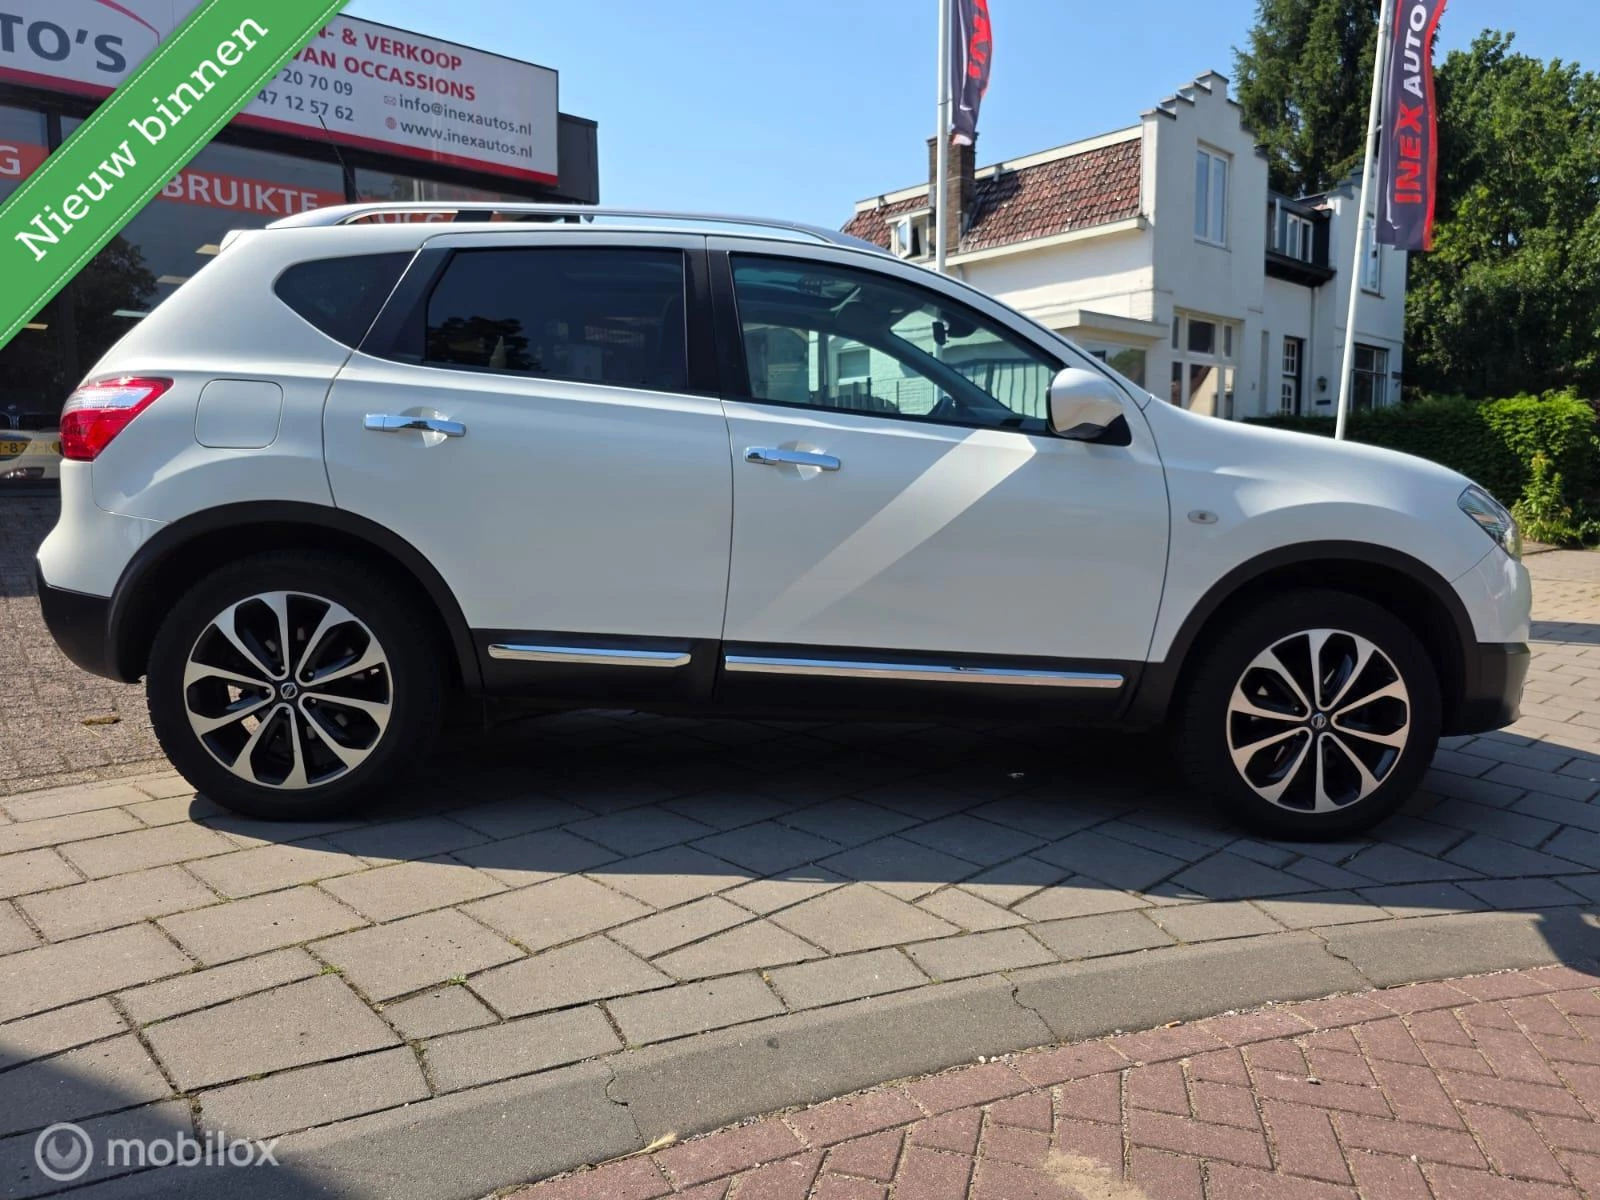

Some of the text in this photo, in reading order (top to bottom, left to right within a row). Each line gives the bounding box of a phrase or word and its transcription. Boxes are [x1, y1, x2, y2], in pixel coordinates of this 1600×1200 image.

[342, 28, 357, 47] &
[365, 33, 462, 71] VERKOOP
[283, 69, 353, 96] 20 70 09
[344, 56, 476, 102] OCCASSIONS
[257, 89, 354, 121] 47 12 57 62
[400, 94, 532, 136] info@inexautos.nl
[1394, 0, 1428, 204] INEX AUTO
[400, 121, 532, 158] www.inexautos.nl
